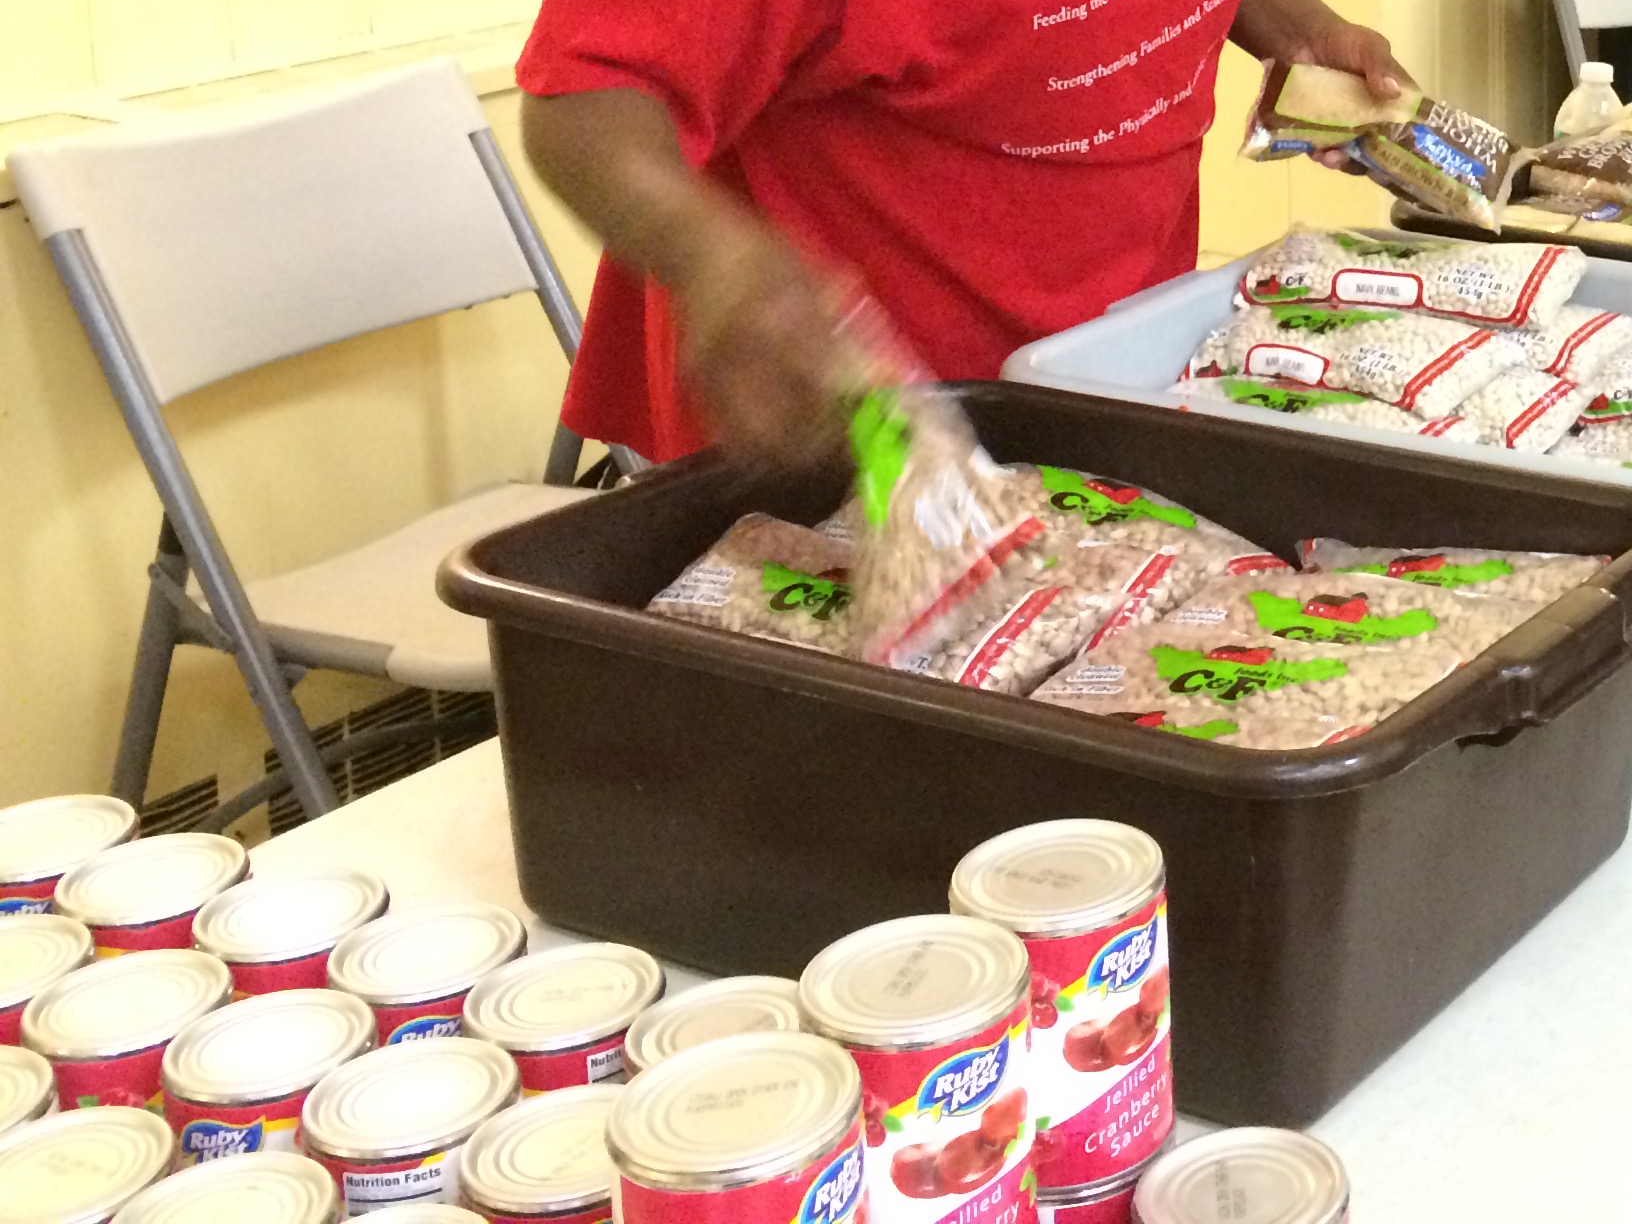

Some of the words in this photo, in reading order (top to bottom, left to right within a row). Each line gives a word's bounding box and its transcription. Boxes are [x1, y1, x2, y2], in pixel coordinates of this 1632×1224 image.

[1033, 1, 1088, 30] Feeding
[1048, 51, 1138, 92] Strengthening
[1139, 23, 1182, 57] Families
[1183, 6, 1202, 30] and
[1001, 135, 1090, 158] Supporting
[1093, 129, 1115, 147] the
[1119, 98, 1170, 137] Physically
[1173, 82, 1193, 105] and
[1355, 283, 1374, 294] NAVY
[1375, 284, 1400, 297] BEANS
[1168, 668, 1267, 701] C&F
[0, 901, 50, 916] uby
[1101, 924, 1153, 977] Ruby
[1115, 940, 1152, 990] Kist
[590, 1047, 623, 1068] Nutrit
[934, 1046, 1000, 1099] Ruby
[951, 1061, 1000, 1112] Kist
[1104, 1055, 1155, 1113] Jellied
[1084, 1072, 1167, 1154] Cranberry
[1111, 1103, 1160, 1158] Sauce
[189, 1129, 250, 1150] Ruby
[199, 1140, 249, 1165] Kist
[346, 1175, 401, 1189] Nutrition
[404, 1166, 442, 1184] Facts
[814, 1147, 861, 1213] Ruby
[949, 1183, 1003, 1224] llied
